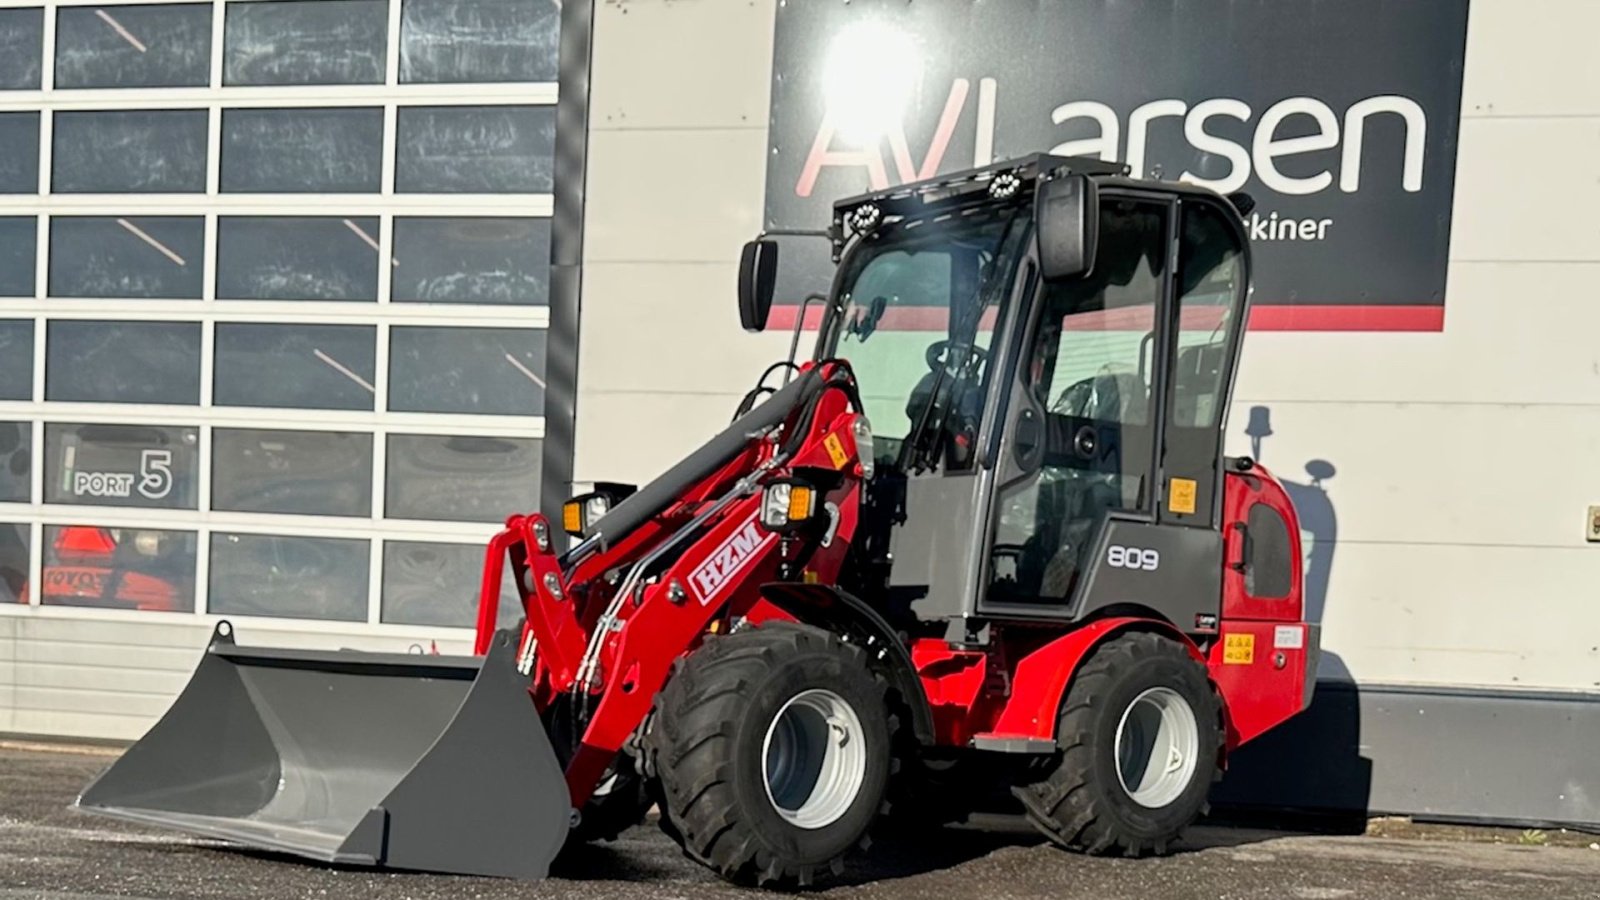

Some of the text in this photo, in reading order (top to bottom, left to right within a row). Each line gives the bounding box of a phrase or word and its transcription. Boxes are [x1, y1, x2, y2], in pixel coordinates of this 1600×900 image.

[1242, 211, 1333, 240] kiner
[74, 449, 173, 499] PORT 5
[695, 521, 763, 596] HZM
[1107, 545, 1160, 571] 809
